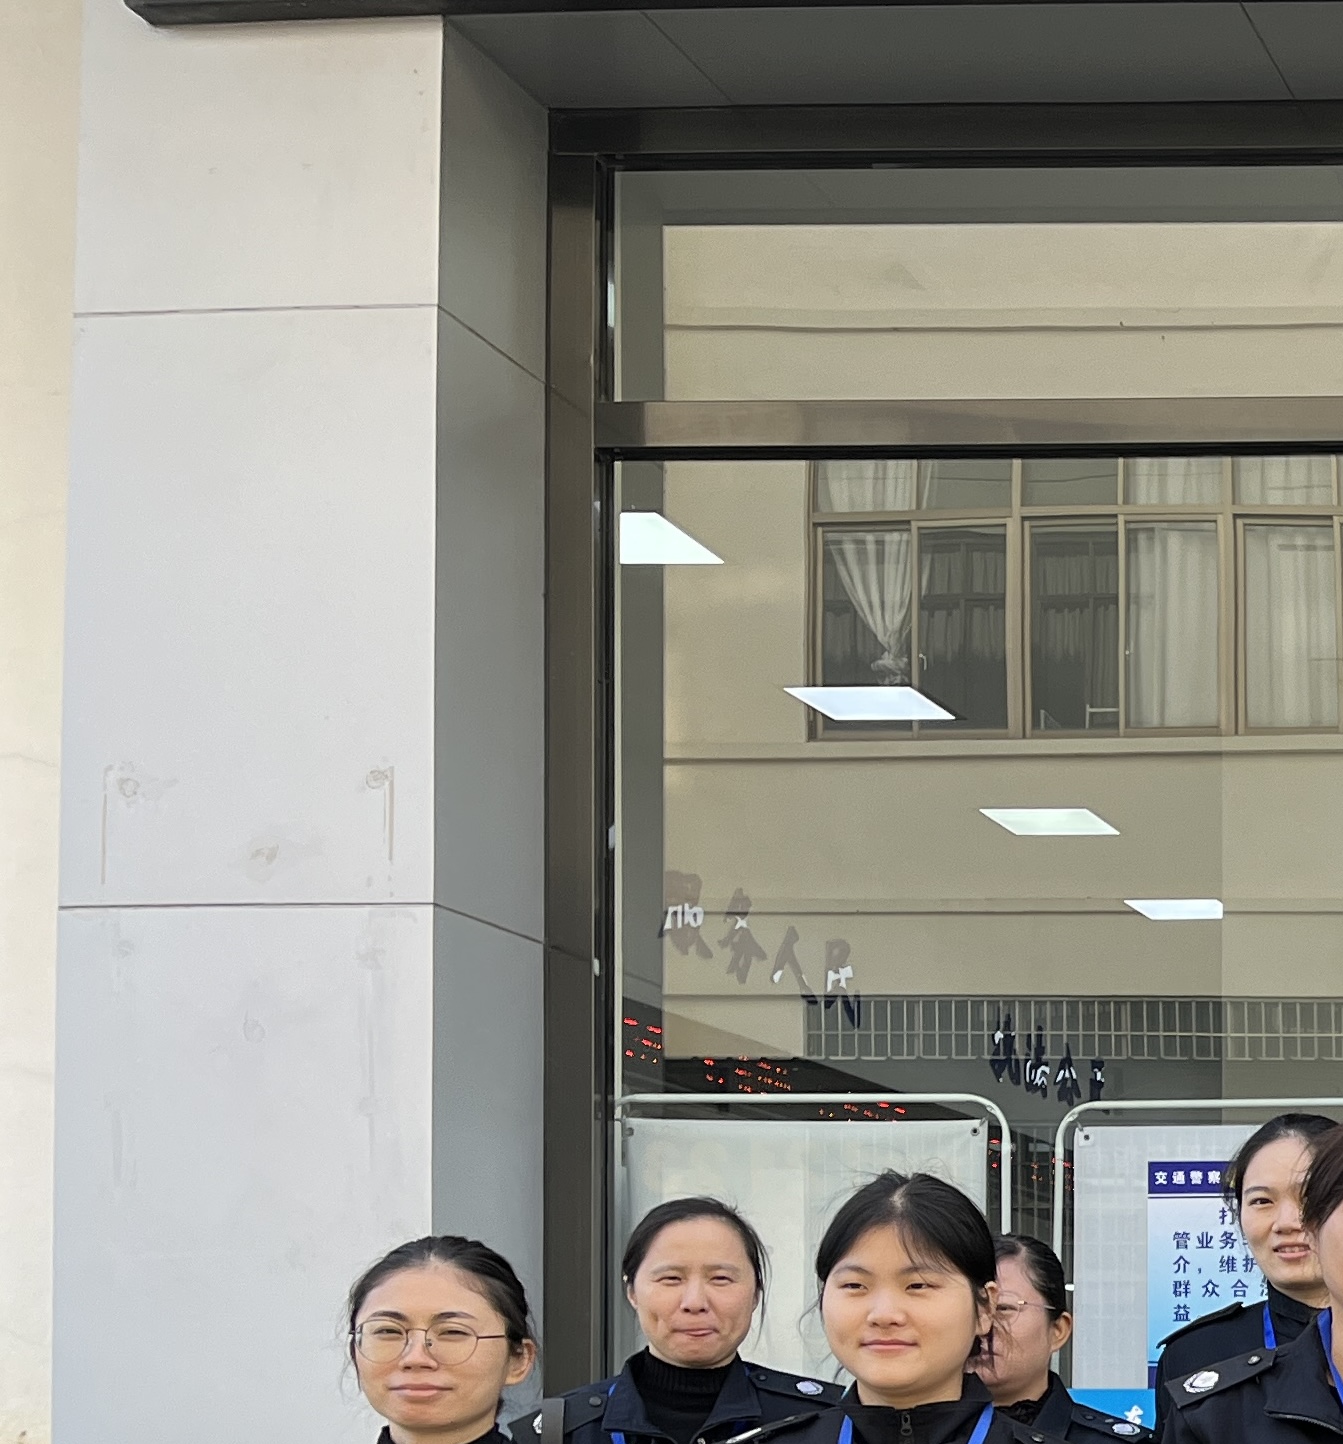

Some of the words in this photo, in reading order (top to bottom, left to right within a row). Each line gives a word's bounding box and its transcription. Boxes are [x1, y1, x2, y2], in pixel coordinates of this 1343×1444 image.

[1154, 1170, 1221, 1185] 交通警察
[1172, 1231, 1248, 1250] 管业务
